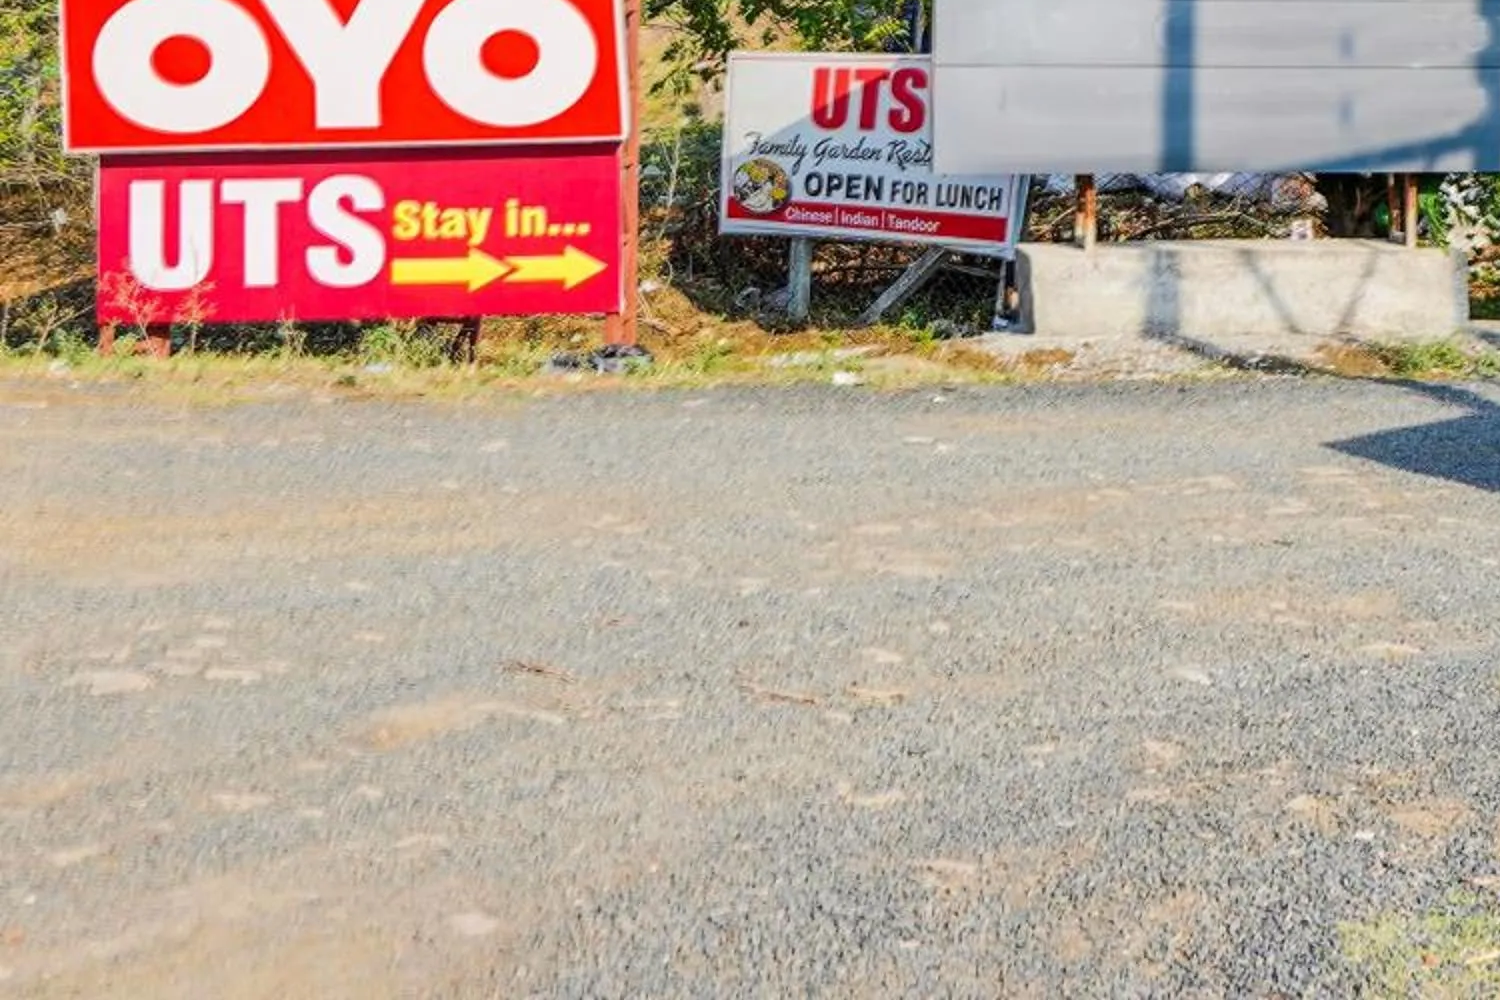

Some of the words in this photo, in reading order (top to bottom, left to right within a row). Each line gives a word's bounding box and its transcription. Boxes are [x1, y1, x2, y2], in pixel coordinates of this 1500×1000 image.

[809, 65, 930, 134] UTS
[745, 131, 808, 177] Family
[814, 136, 884, 167] Garden
[804, 171, 885, 202] OPEN
[890, 180, 930, 206] FOR
[935, 184, 1004, 211] LUNCH
[128, 174, 388, 292] UTS
[393, 200, 491, 246] Stay
[504, 201, 591, 237] in...
[785, 205, 834, 224] Chinese
[840, 210, 880, 228] Indian
[887, 214, 942, 233] Tandoor
